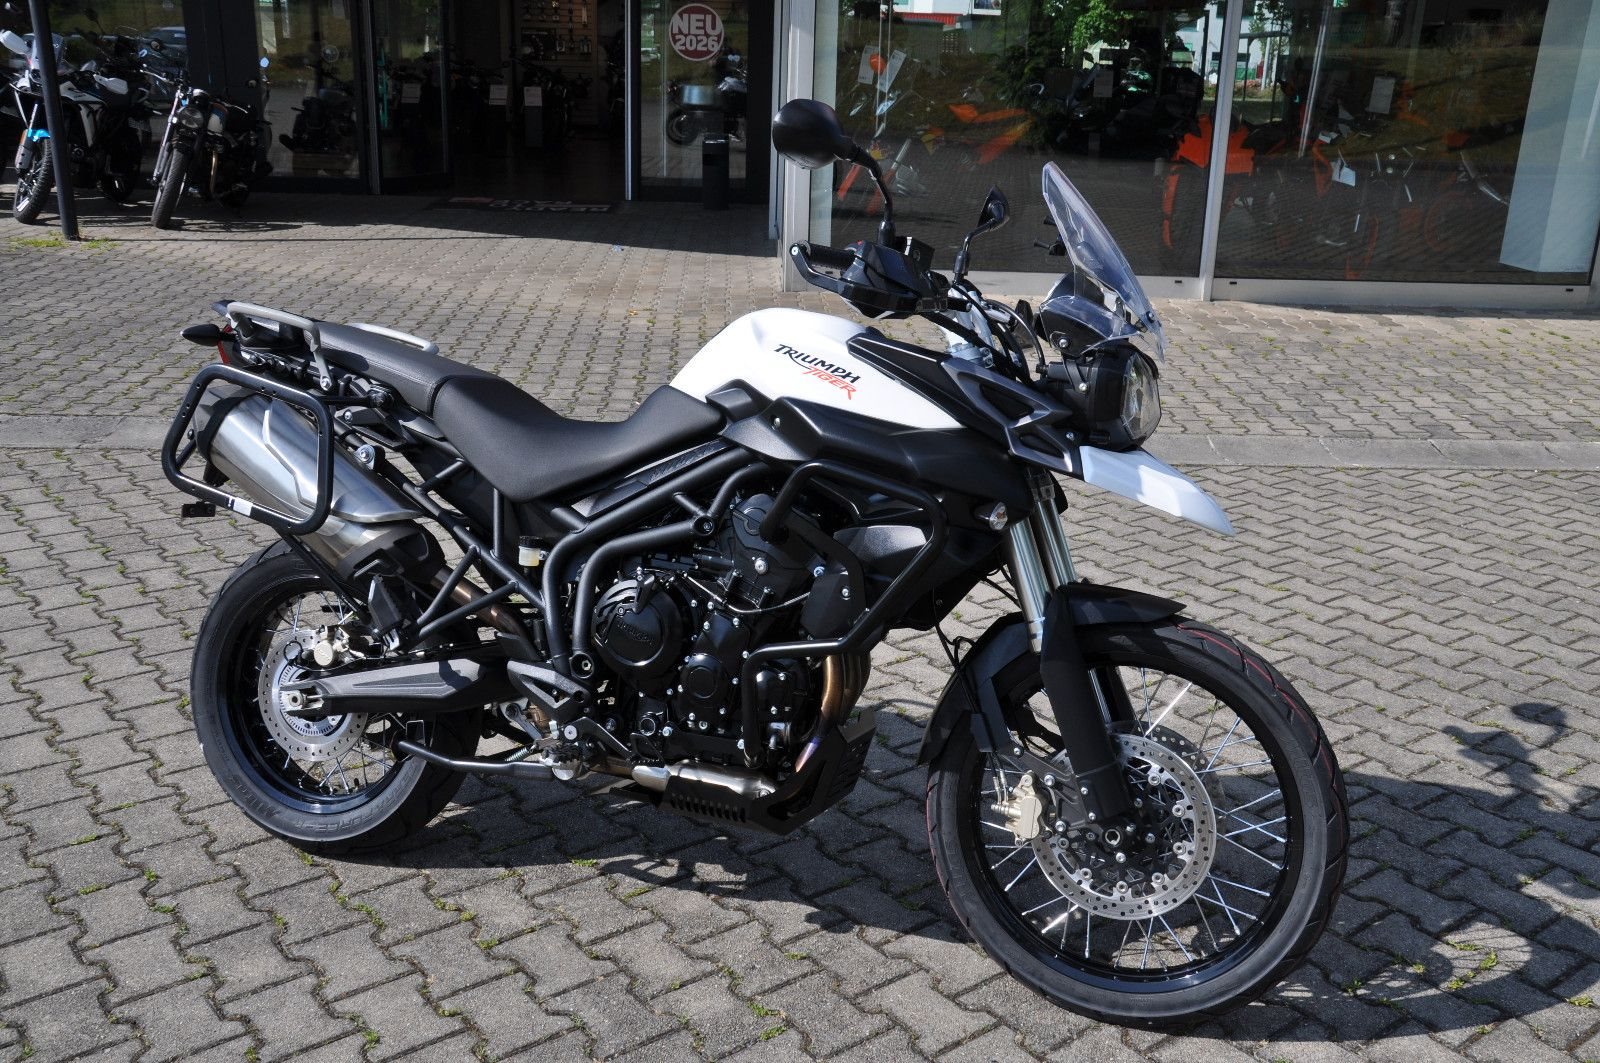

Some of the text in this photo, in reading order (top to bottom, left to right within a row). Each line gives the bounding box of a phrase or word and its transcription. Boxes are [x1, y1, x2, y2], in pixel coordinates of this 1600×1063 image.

[672, 14, 722, 35] NEU
[674, 35, 720, 51] 2026
[774, 344, 861, 384] TRIUMPH
[801, 365, 857, 400] TIGER
